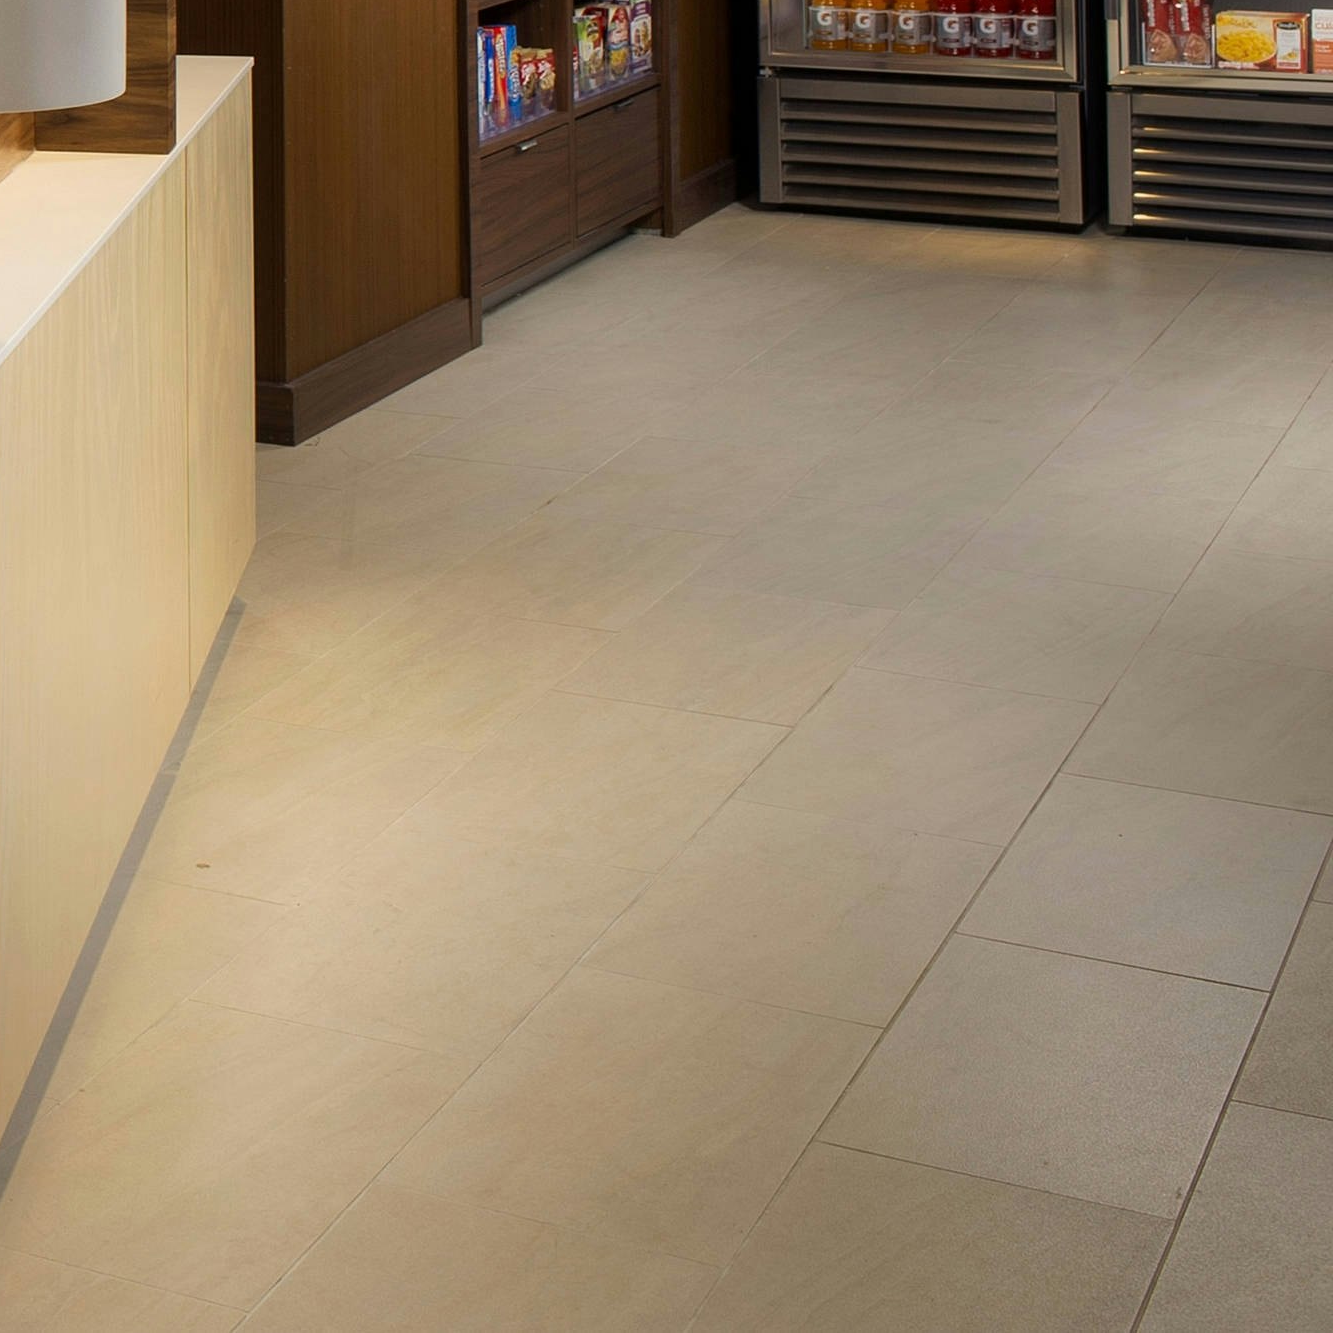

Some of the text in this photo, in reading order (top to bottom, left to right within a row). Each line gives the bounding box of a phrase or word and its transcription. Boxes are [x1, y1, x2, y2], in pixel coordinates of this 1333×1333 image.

[817, 11, 832, 26] G
[856, 12, 871, 29] G
[898, 14, 914, 30] G
[943, 17, 960, 34] G
[979, 18, 997, 34] G
[1022, 20, 1039, 36] G
